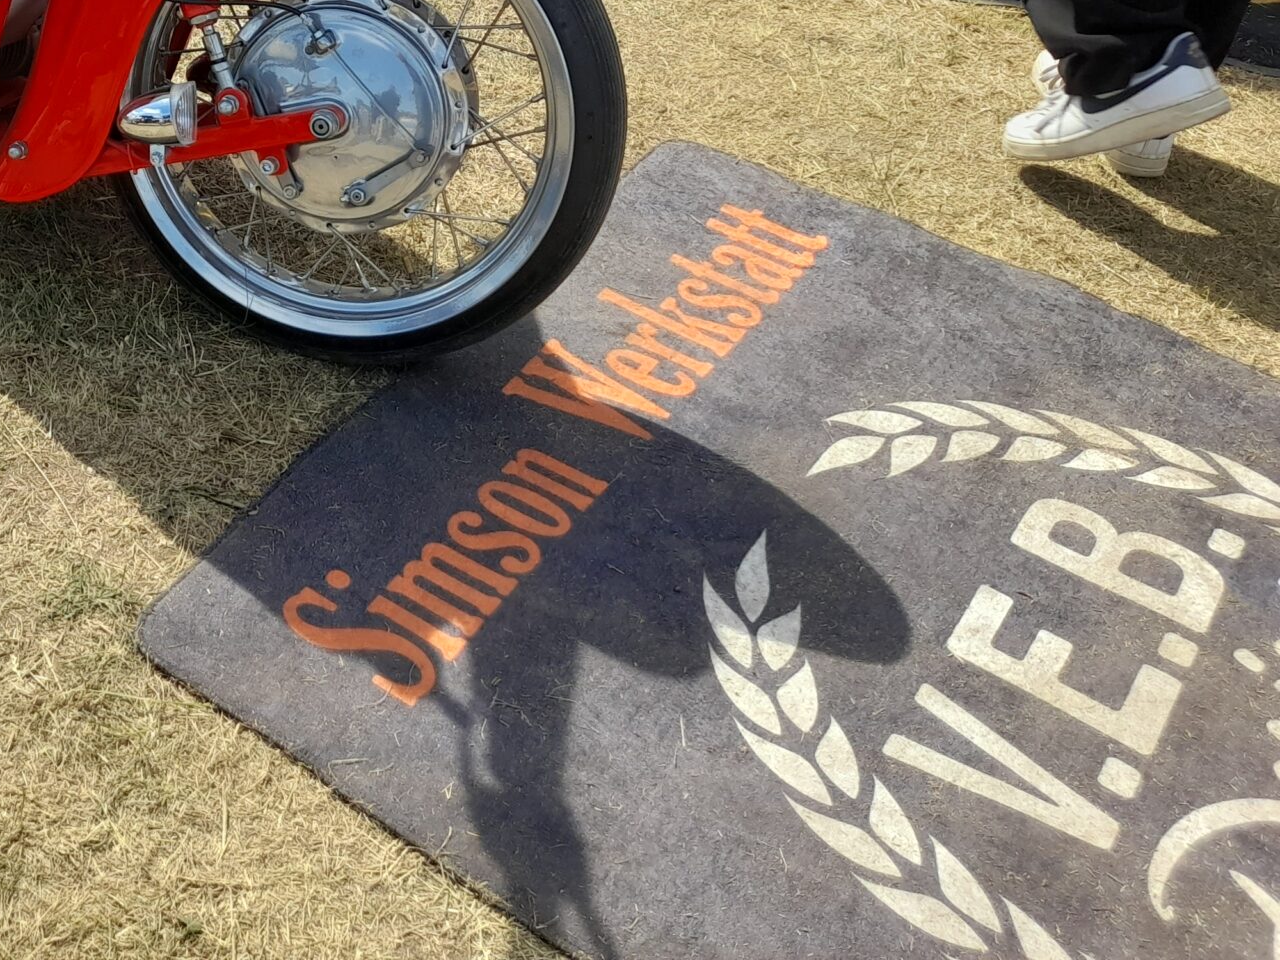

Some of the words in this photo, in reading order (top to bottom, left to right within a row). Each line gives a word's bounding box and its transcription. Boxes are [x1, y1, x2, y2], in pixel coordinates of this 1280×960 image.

[282, 447, 610, 707] Simson
[502, 203, 828, 440] Werkstatt
[883, 497, 1248, 851] V.E.B.
